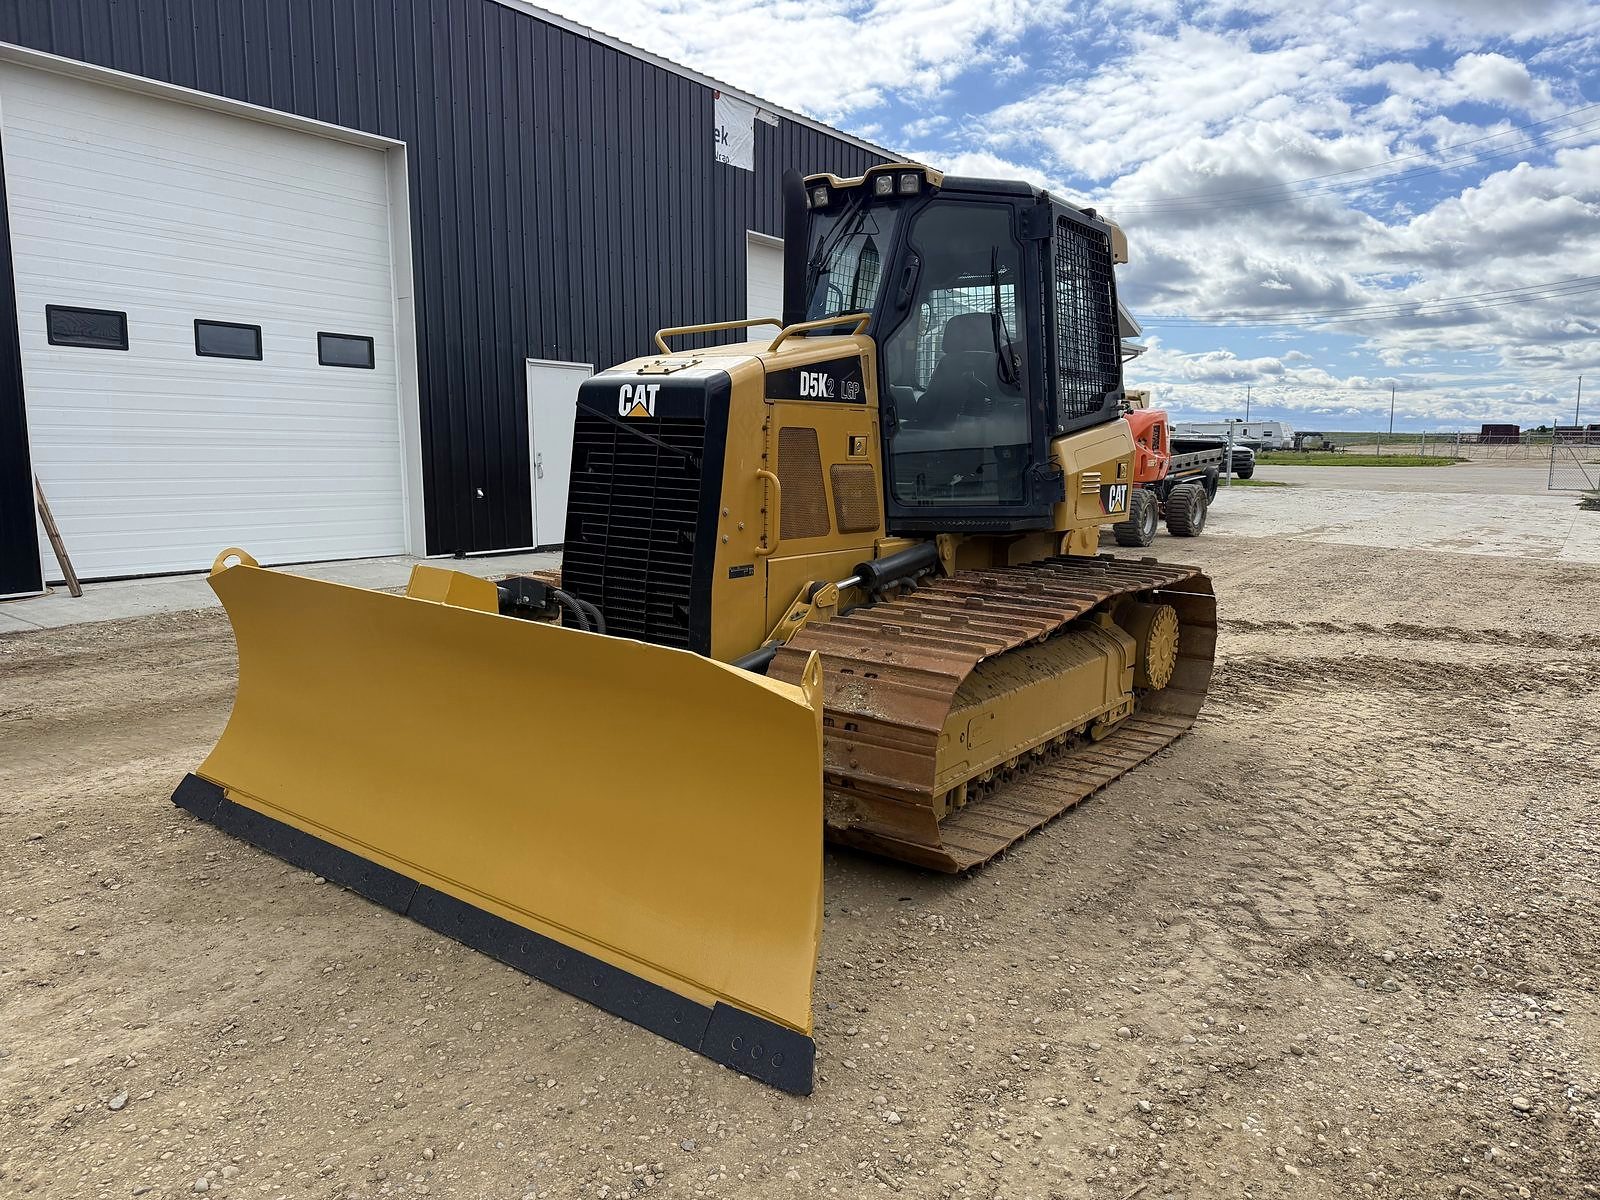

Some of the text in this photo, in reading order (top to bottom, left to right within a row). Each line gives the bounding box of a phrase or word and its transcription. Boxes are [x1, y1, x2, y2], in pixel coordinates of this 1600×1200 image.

[618, 383, 661, 417] CAT
[840, 380, 860, 400] LGP
[1108, 484, 1128, 513] CAT
